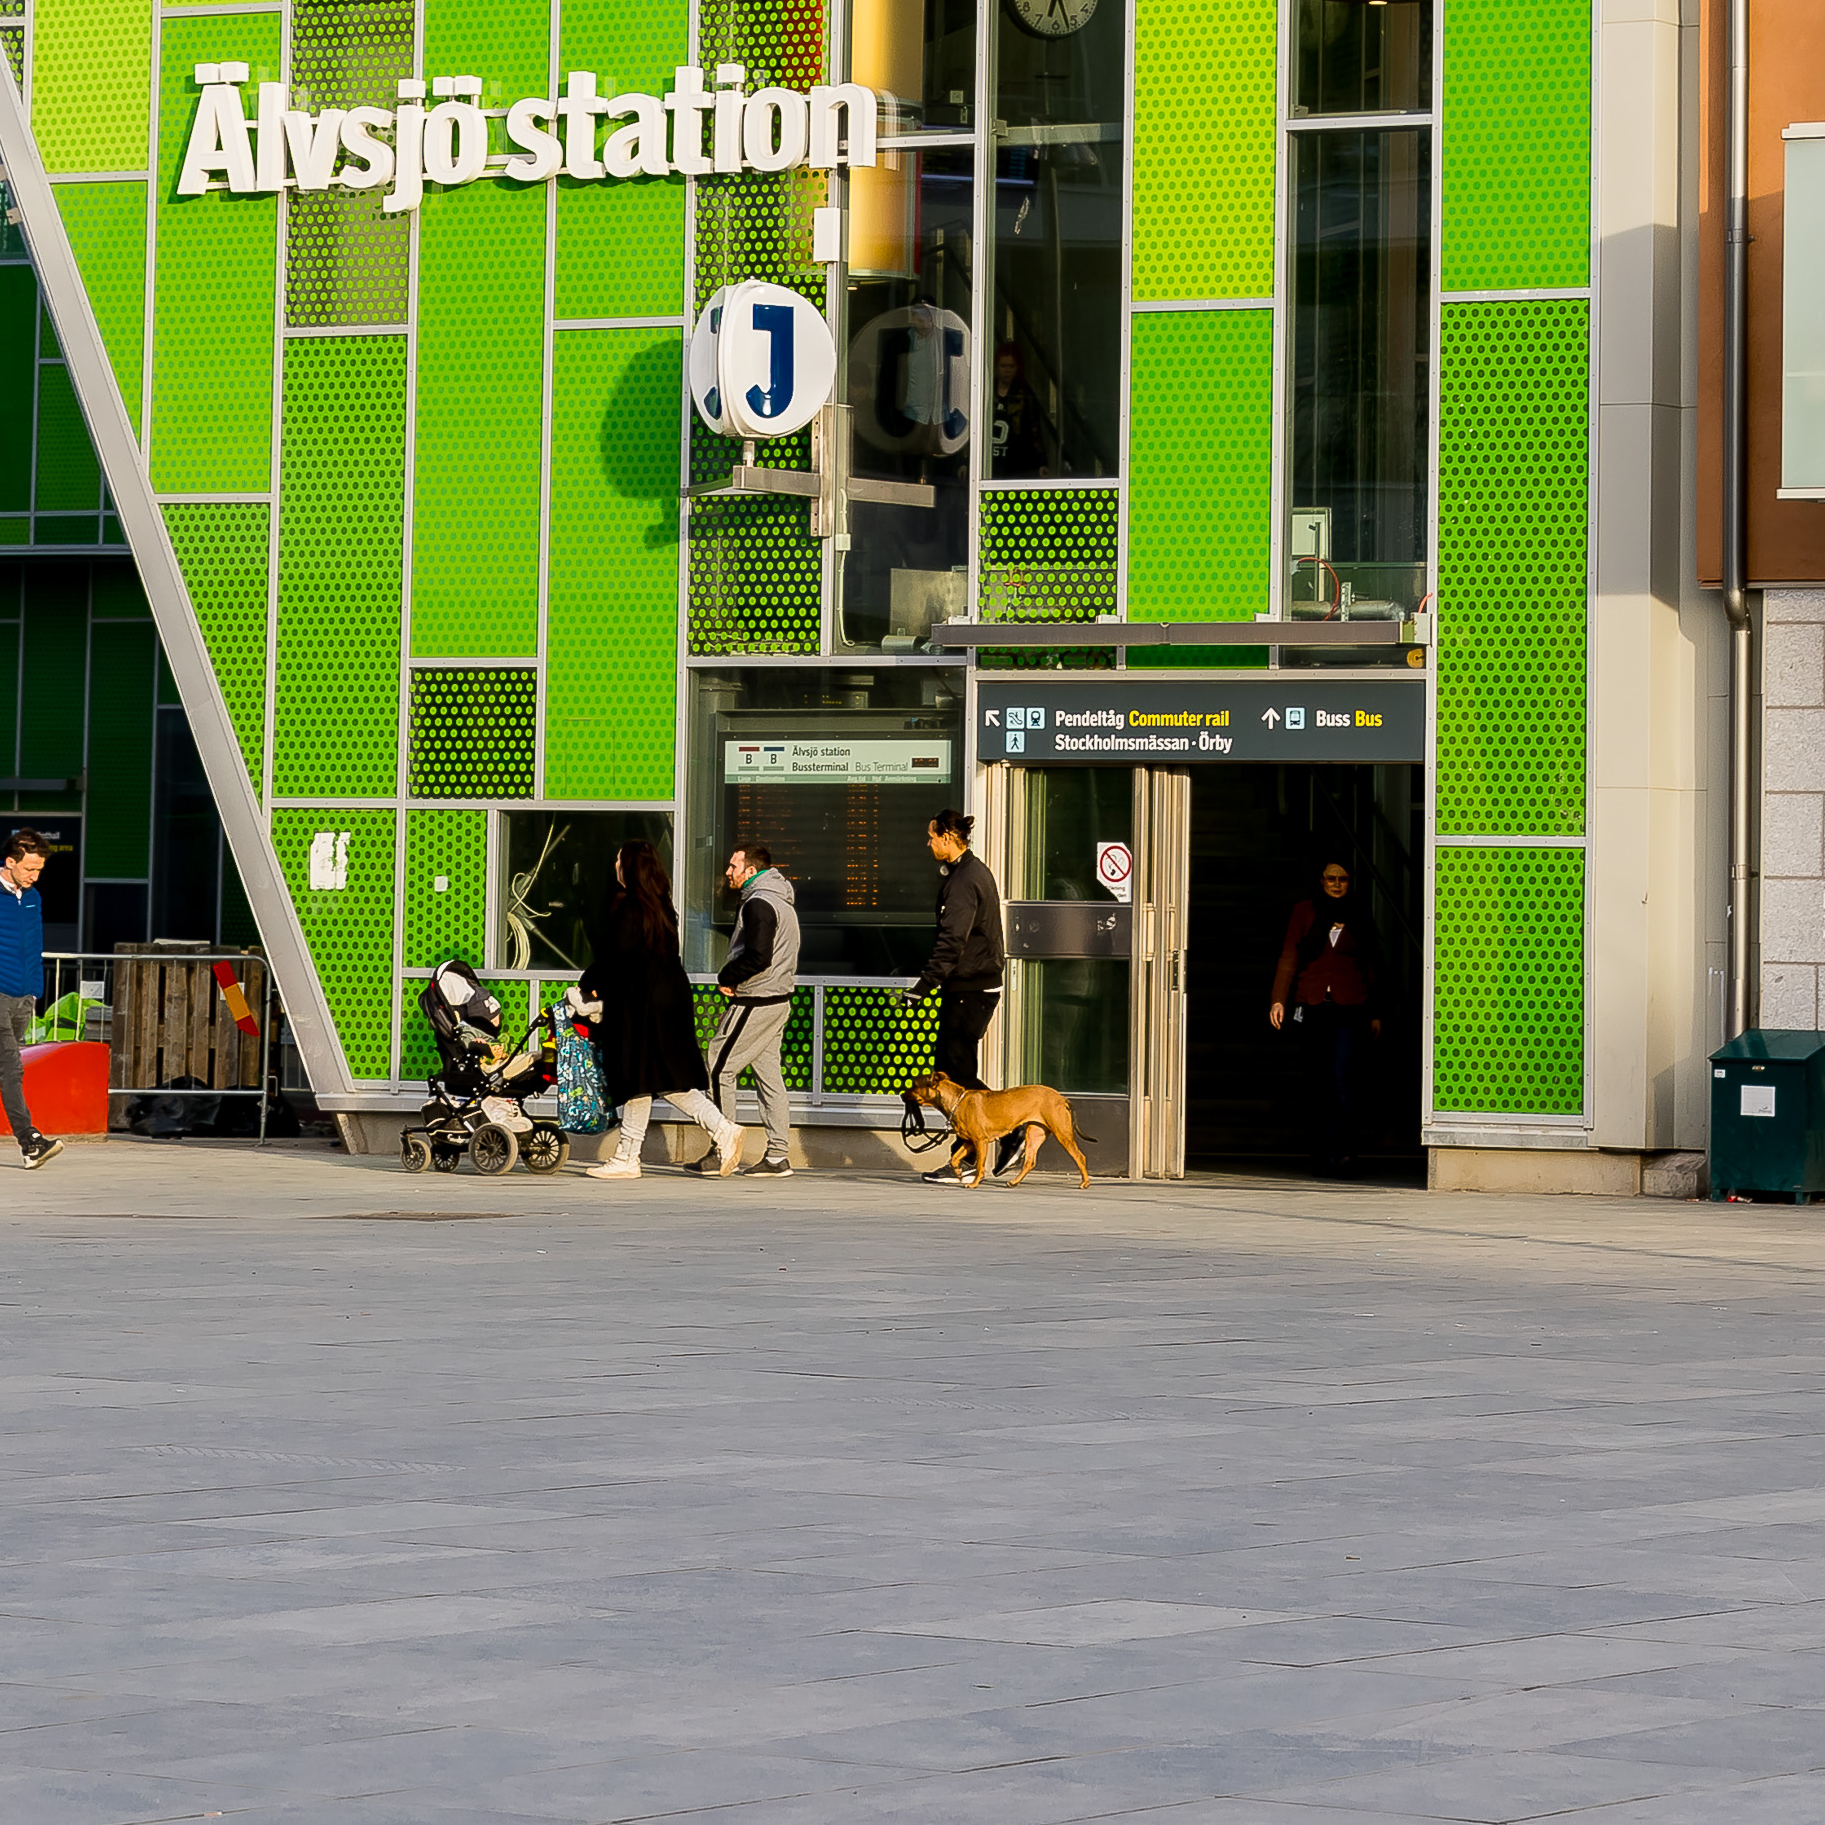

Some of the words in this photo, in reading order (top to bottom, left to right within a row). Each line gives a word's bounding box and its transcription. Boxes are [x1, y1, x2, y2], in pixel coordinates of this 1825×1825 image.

[177, 61, 487, 213] Älvsjö
[504, 62, 879, 181] station
[744, 303, 795, 419] J
[1055, 709, 1125, 731] Pendeltåg
[1128, 710, 1203, 727] Commuter
[1205, 709, 1230, 727] rail
[1316, 710, 1351, 727] Buss
[1355, 710, 1383, 727] Bus
[792, 744, 819, 760] Älvsjö
[821, 747, 851, 757] station
[1054, 732, 1189, 751] Stockholmsmässan
[1198, 731, 1233, 754] Örby
[745, 754, 753, 765] B
[770, 754, 777, 765] B
[792, 762, 849, 772] Bussterminal
[855, 762, 872, 772] Bus
[873, 762, 908, 772] Terminal
